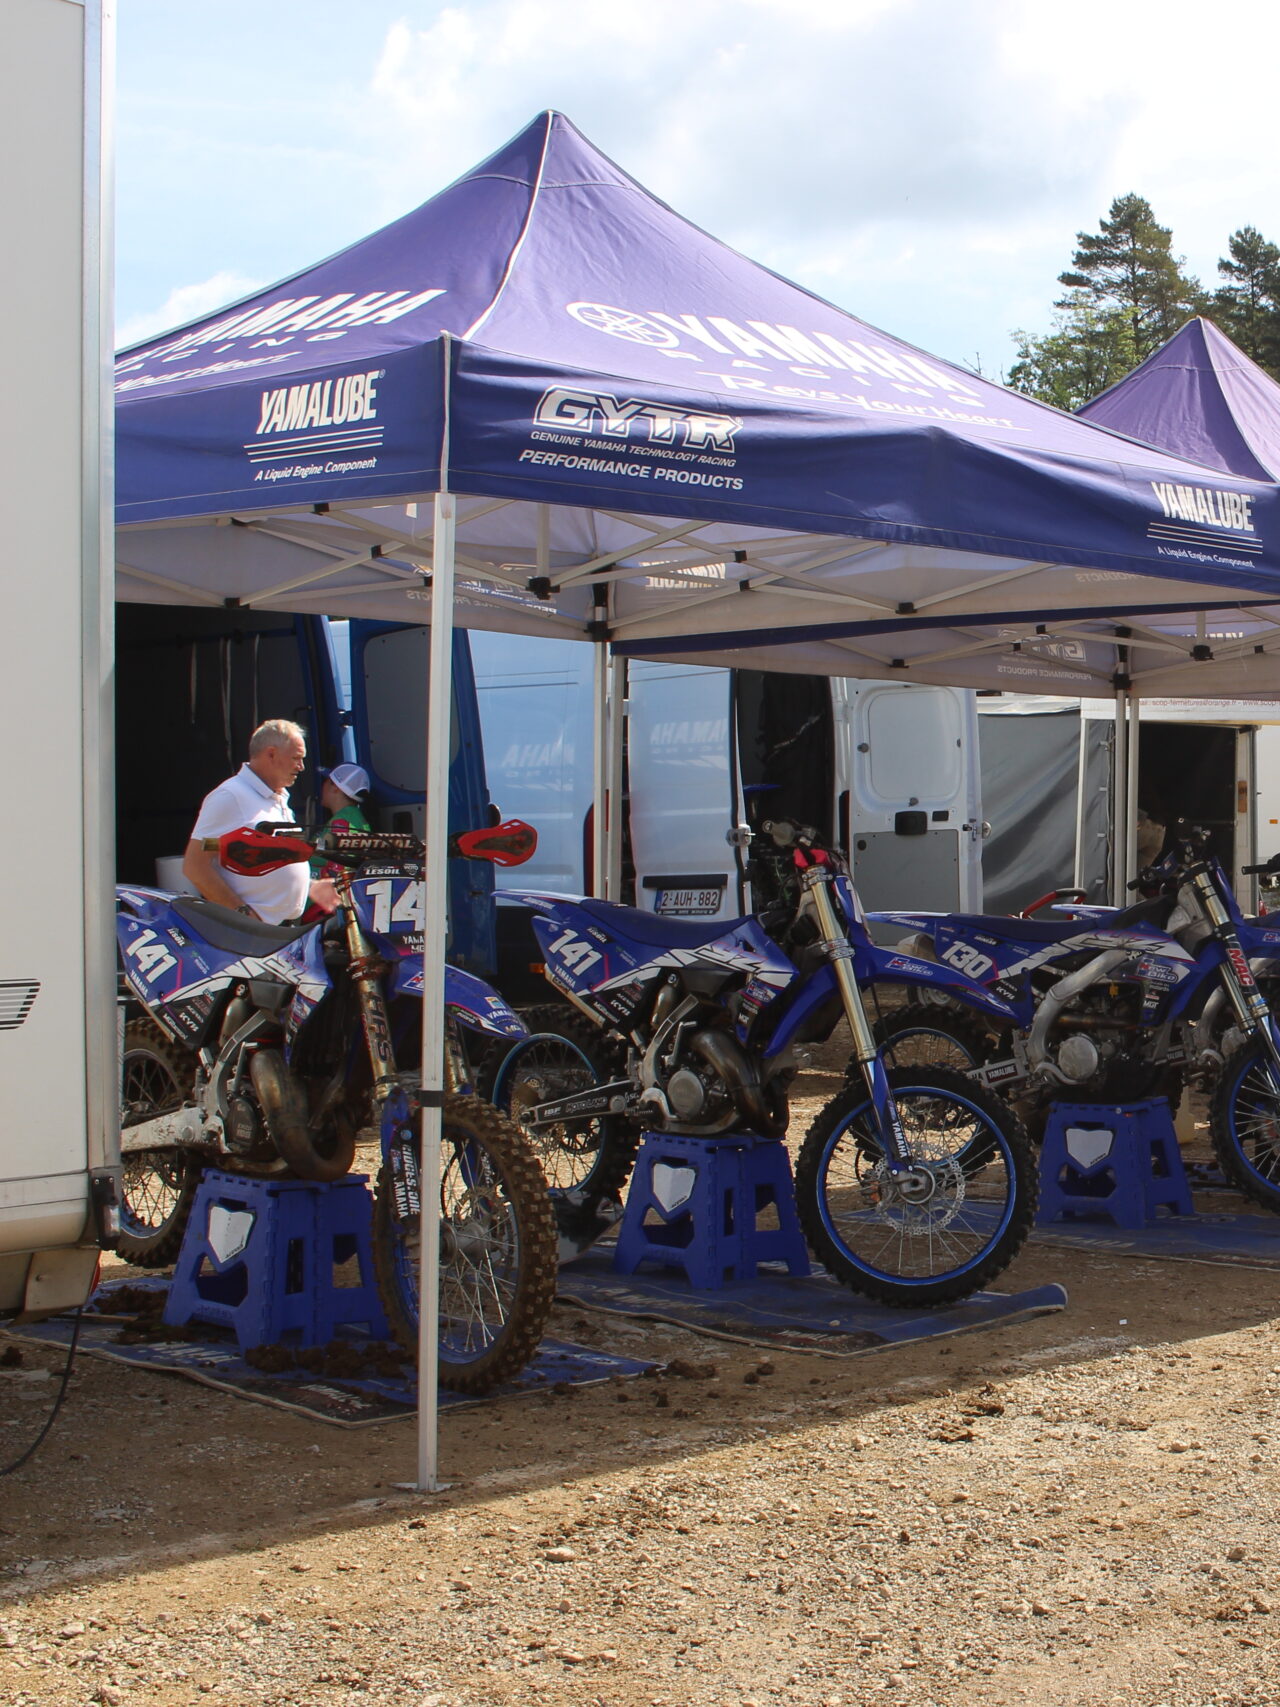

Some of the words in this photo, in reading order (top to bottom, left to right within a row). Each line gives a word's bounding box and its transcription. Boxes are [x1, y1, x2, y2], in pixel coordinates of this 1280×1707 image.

[646, 311, 981, 397] YAMAHA
[256, 370, 380, 435] YAMALUBE
[533, 385, 742, 453] GYTR
[531, 431, 581, 448] GENUINE
[582, 438, 627, 453] YAMAHA
[628, 445, 699, 464] TECHNOLOGY
[697, 455, 736, 468] RACING
[254, 470, 263, 482] A
[264, 466, 293, 482] Liquid
[292, 464, 323, 479] Engine
[325, 456, 378, 474] Component
[518, 449, 651, 479] PERFORMANCE
[653, 467, 744, 491] PRODUCTS
[1151, 481, 1254, 532] YAMALUBE
[1164, 547, 1189, 559] Liquid
[365, 867, 401, 876] LESOIL
[366, 879, 425, 934] 14
[662, 891, 718, 906] 2-AUH-882
[126, 928, 178, 984] 141
[403, 936, 425, 945] YAMA
[548, 928, 603, 976] 141
[941, 940, 993, 979] 130
[130, 969, 149, 998] YAMAHA
[554, 965, 577, 989] YAMAHA
[1227, 948, 1255, 986] MAC
[892, 1121, 907, 1159] YAMAHA
